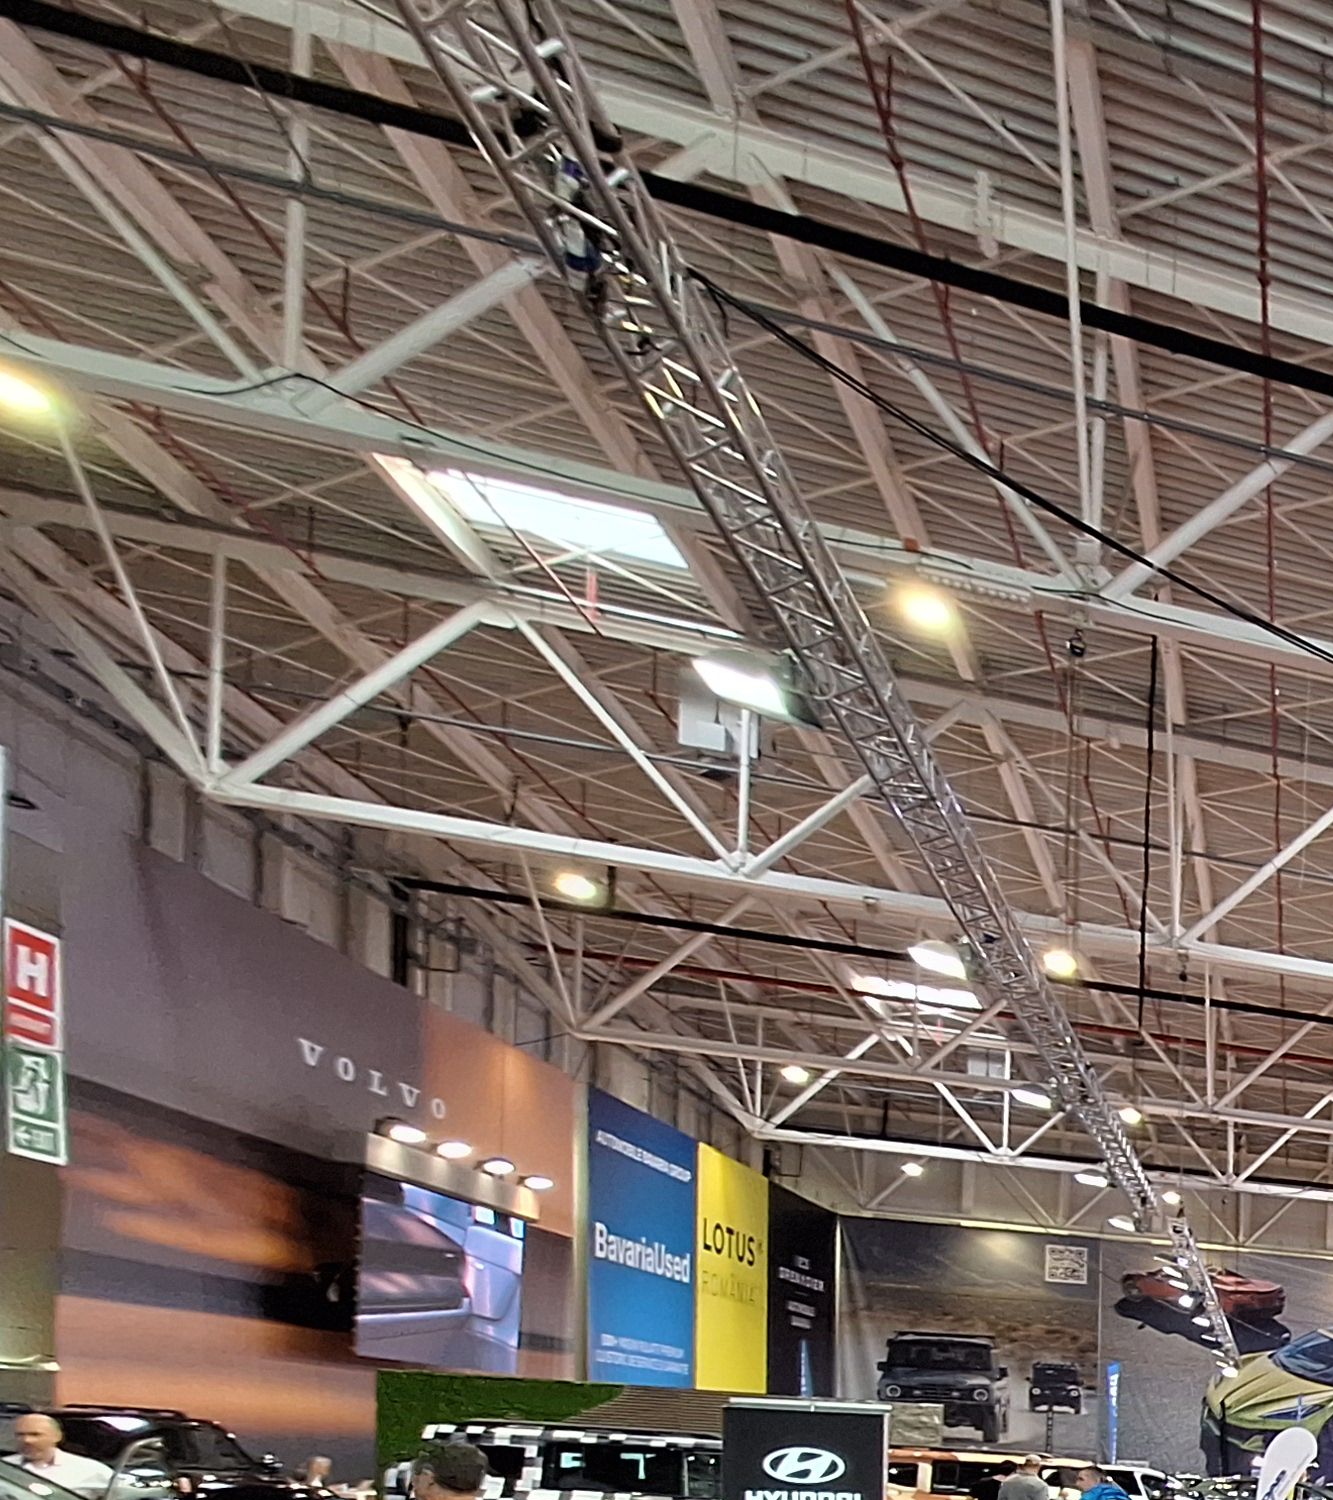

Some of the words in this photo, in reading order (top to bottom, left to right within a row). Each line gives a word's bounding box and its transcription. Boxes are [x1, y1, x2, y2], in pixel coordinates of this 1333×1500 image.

[298, 1037, 447, 1120] VOLVO
[594, 1221, 691, 1284] BavariaUsed
[703, 1217, 755, 1267] LOTUS
